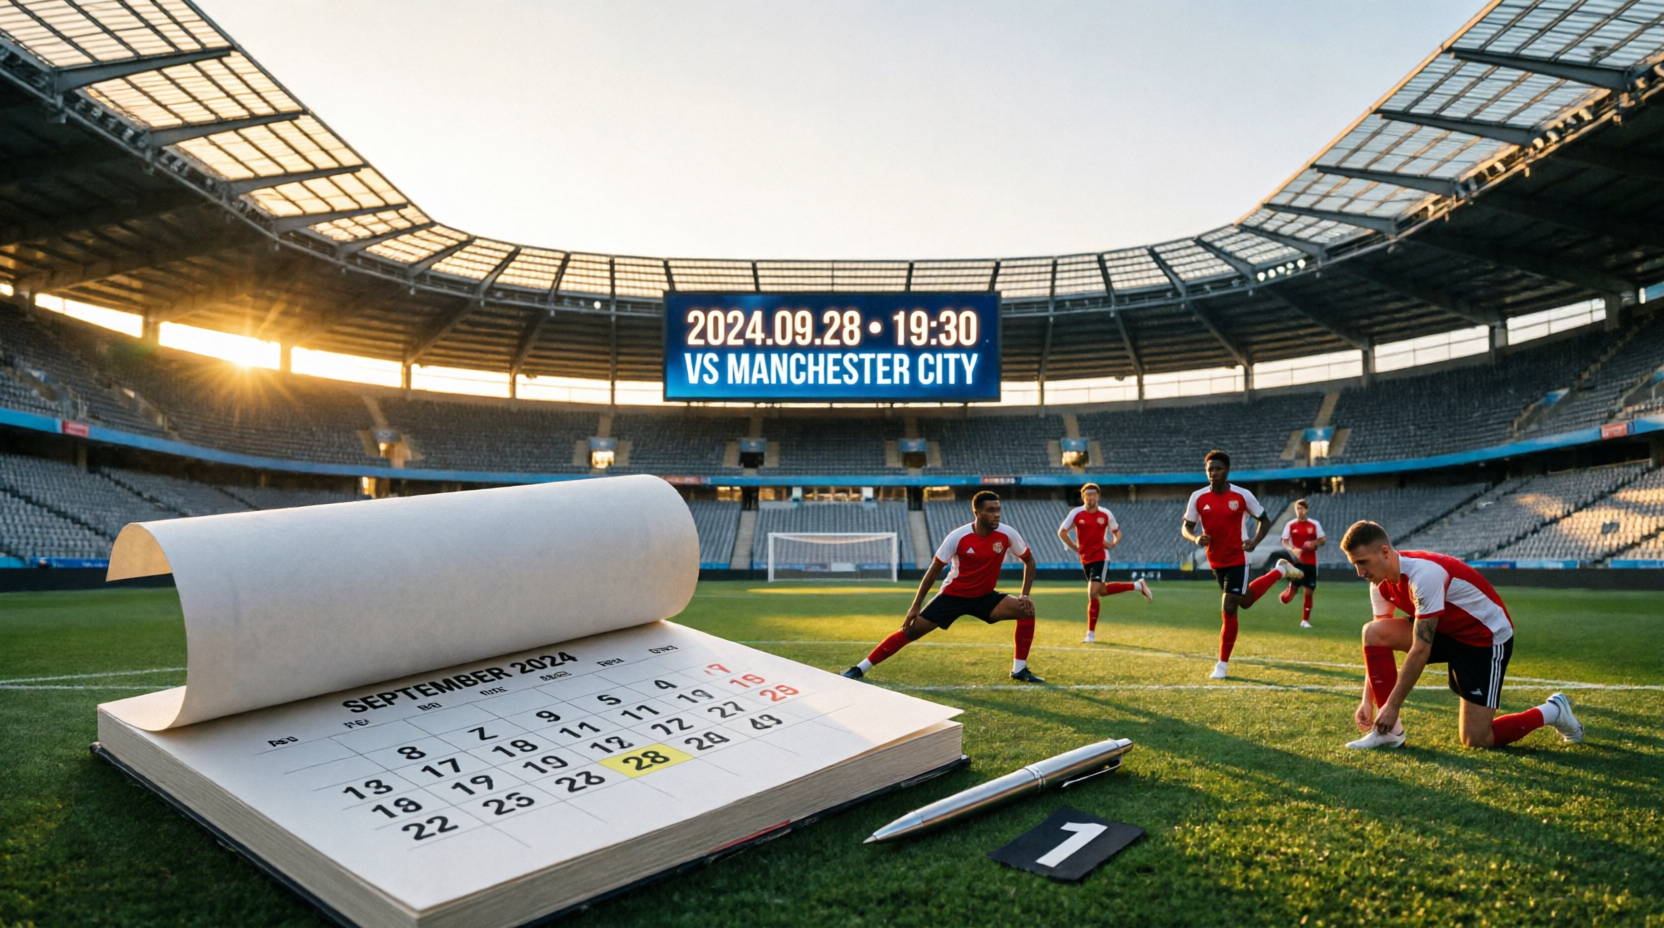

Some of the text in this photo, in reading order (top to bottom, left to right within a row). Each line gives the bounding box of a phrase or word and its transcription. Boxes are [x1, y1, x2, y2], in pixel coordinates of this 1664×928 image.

[686, 309, 862, 346] 2024.09.28
[892, 310, 979, 346] 19:30
[684, 352, 979, 385] VS MANCHESTER CITY
[342, 652, 578, 713] SEPTEMBER 2024
[396, 746, 427, 760] 8
[535, 710, 561, 723] 9
[596, 694, 622, 706] 5
[653, 679, 678, 690] 4
[420, 757, 461, 778] 17
[491, 739, 539, 758] 18
[559, 721, 601, 739] 11
[620, 704, 660, 721] 11
[401, 815, 460, 841] 22
[621, 750, 671, 771] 28
[451, 774, 495, 796] 19
[522, 755, 569, 774] 19
[1035, 821, 1109, 868] 1
